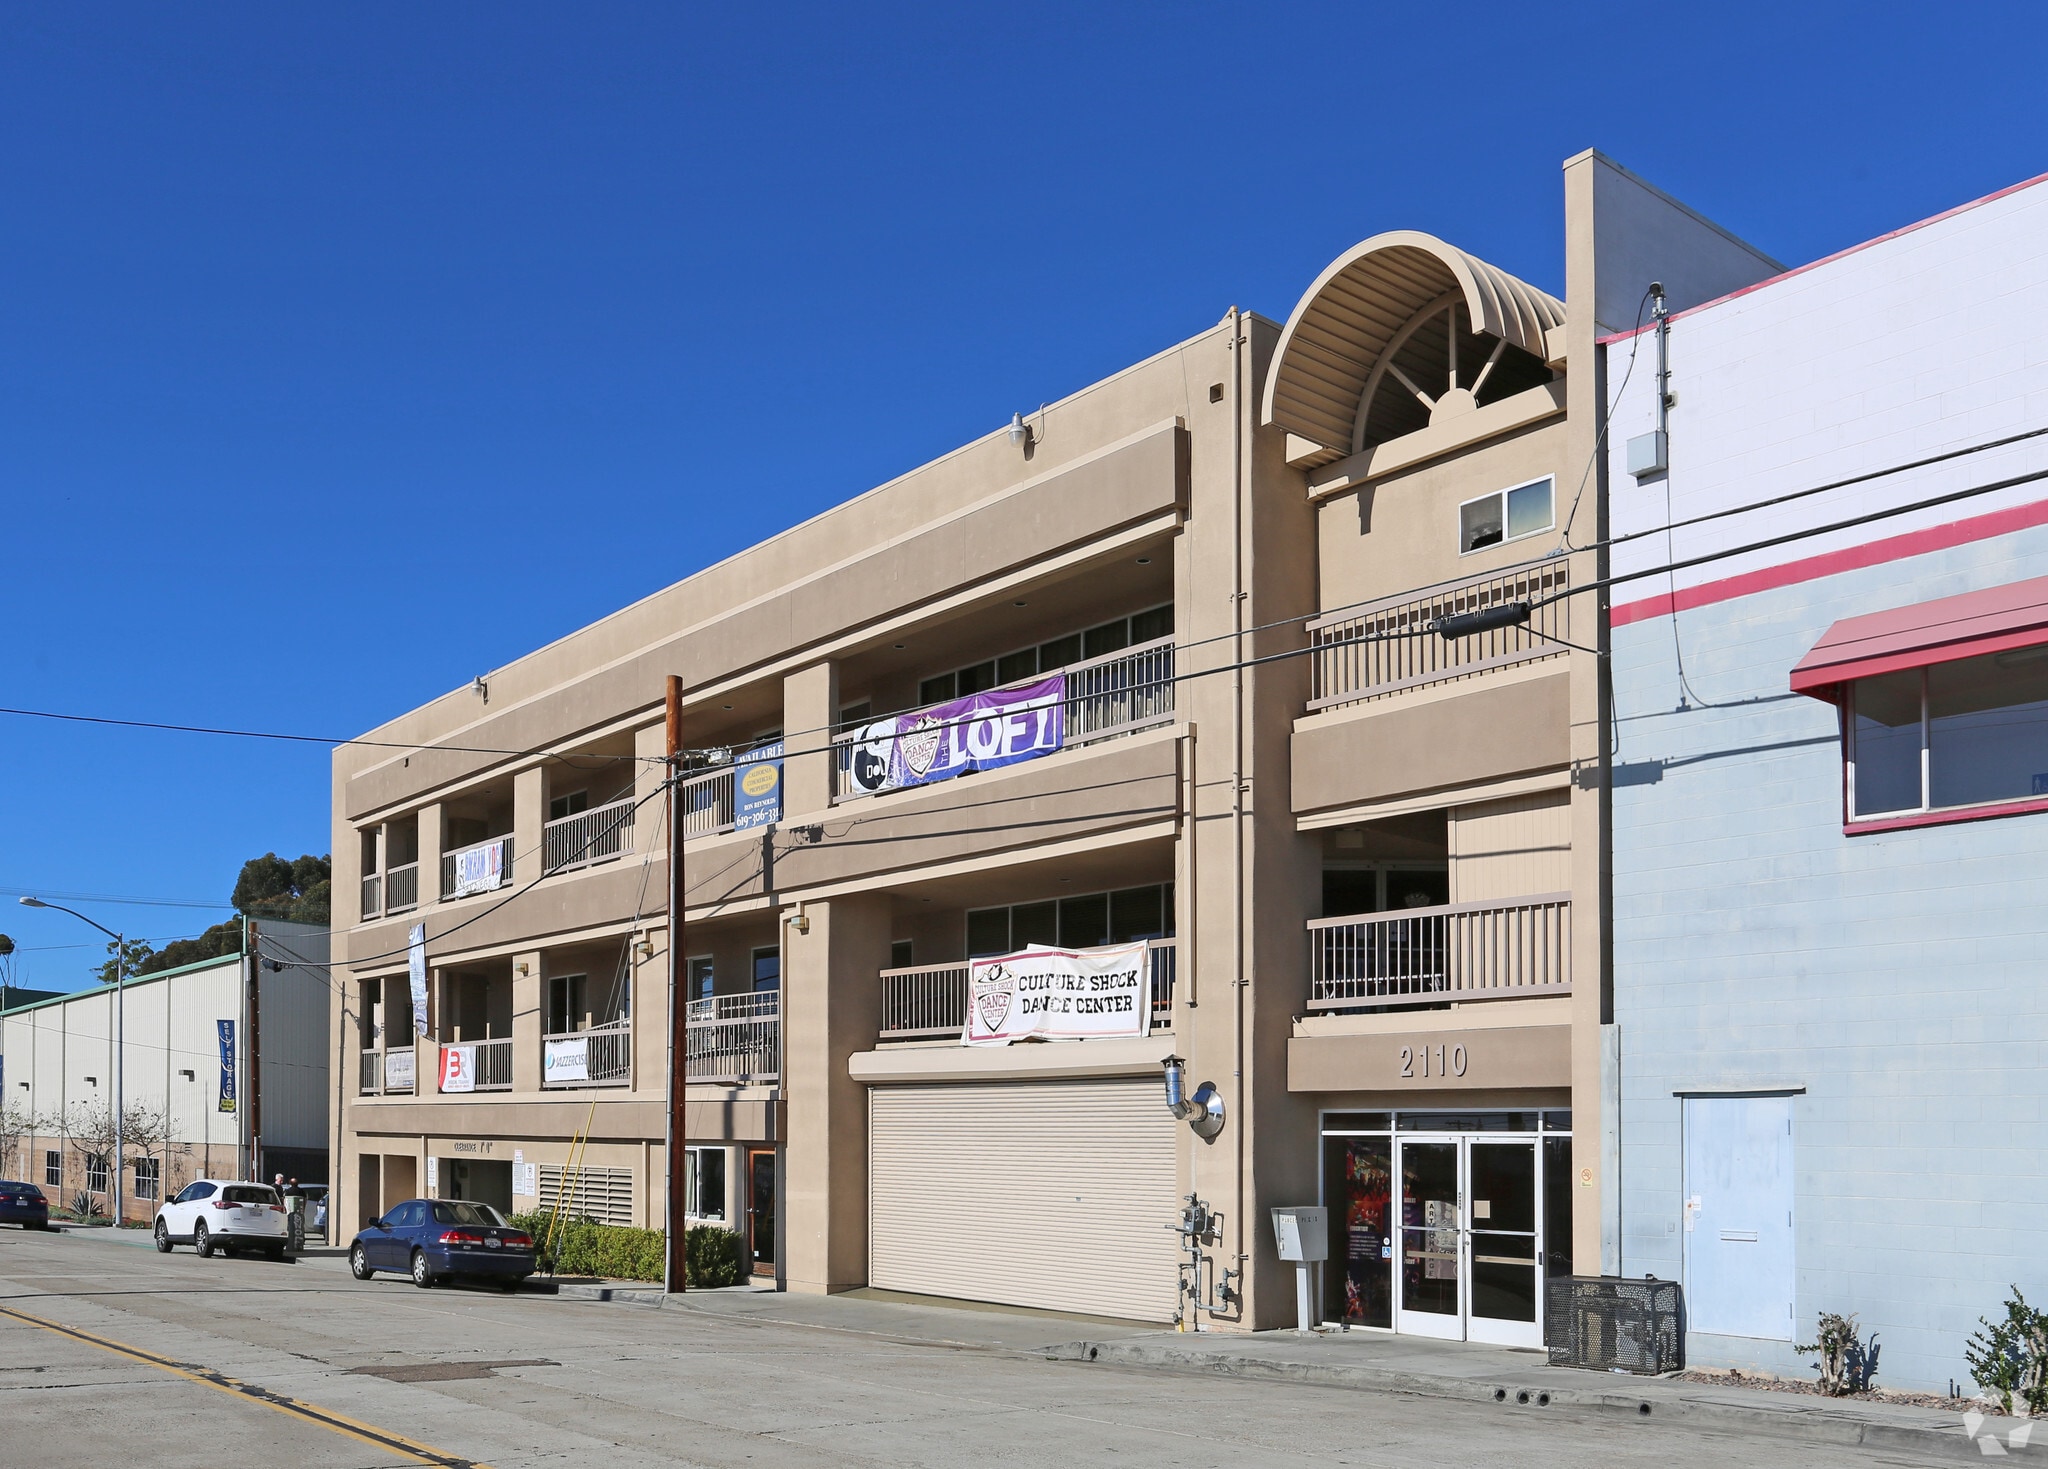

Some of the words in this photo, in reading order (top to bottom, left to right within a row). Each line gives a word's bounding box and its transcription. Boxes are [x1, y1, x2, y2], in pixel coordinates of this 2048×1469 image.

[949, 693, 1058, 767] LOFT
[737, 744, 783, 769] AVAILABLE
[907, 740, 935, 760] DANCE
[940, 738, 949, 764] THE
[975, 983, 997, 996] CULTURE
[998, 979, 1015, 990] SHOCK
[1018, 973, 1086, 992] CULTURE
[1090, 970, 1138, 991] SHOCK
[981, 994, 1008, 1010] DANCE
[1022, 995, 1072, 1014] DANCE
[1076, 995, 1133, 1014] CENTER
[984, 1008, 1004, 1019] CENTER
[1400, 1043, 1468, 1078] 2110
